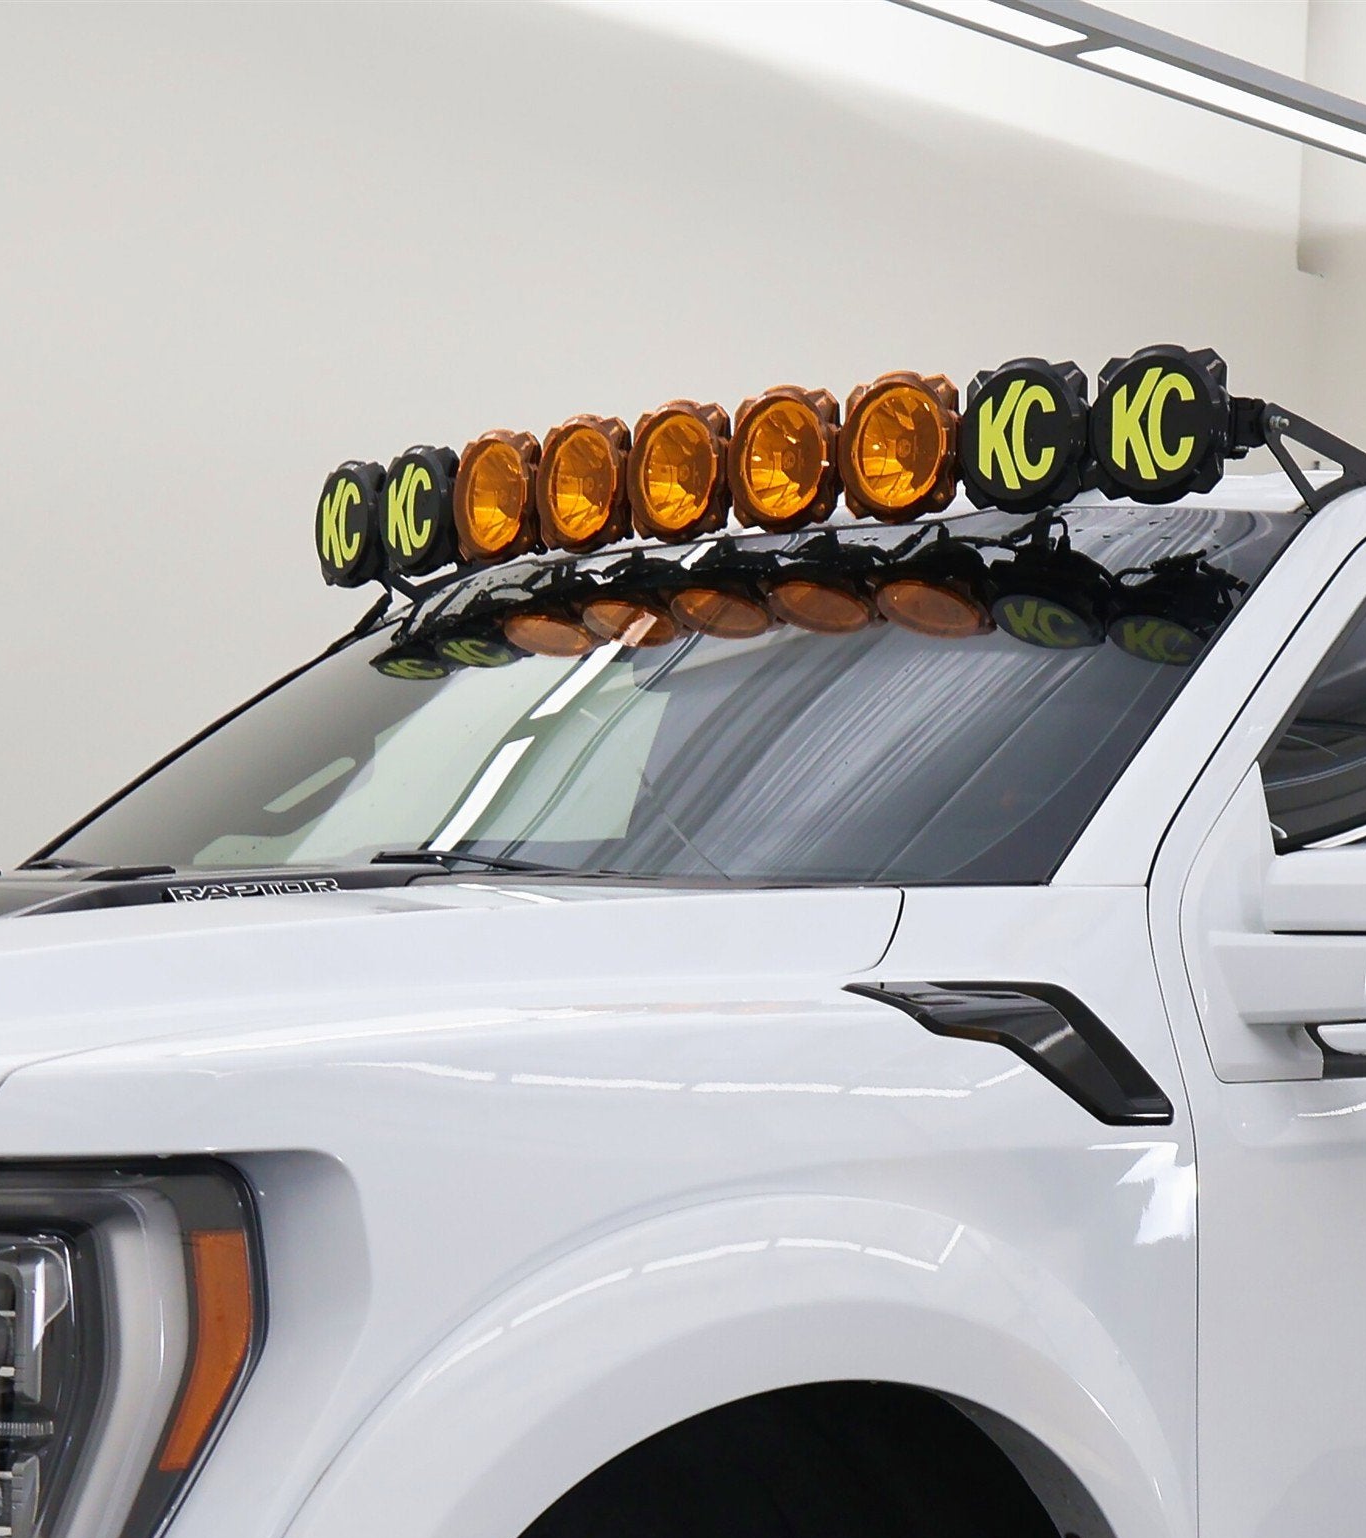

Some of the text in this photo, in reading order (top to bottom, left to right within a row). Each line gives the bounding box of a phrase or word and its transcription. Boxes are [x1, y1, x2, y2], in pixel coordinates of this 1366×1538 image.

[978, 379, 1056, 490] KC
[1111, 366, 1195, 480] KC
[322, 478, 361, 569] KC
[388, 463, 432, 556] KC
[168, 877, 342, 903] RAPTOR
